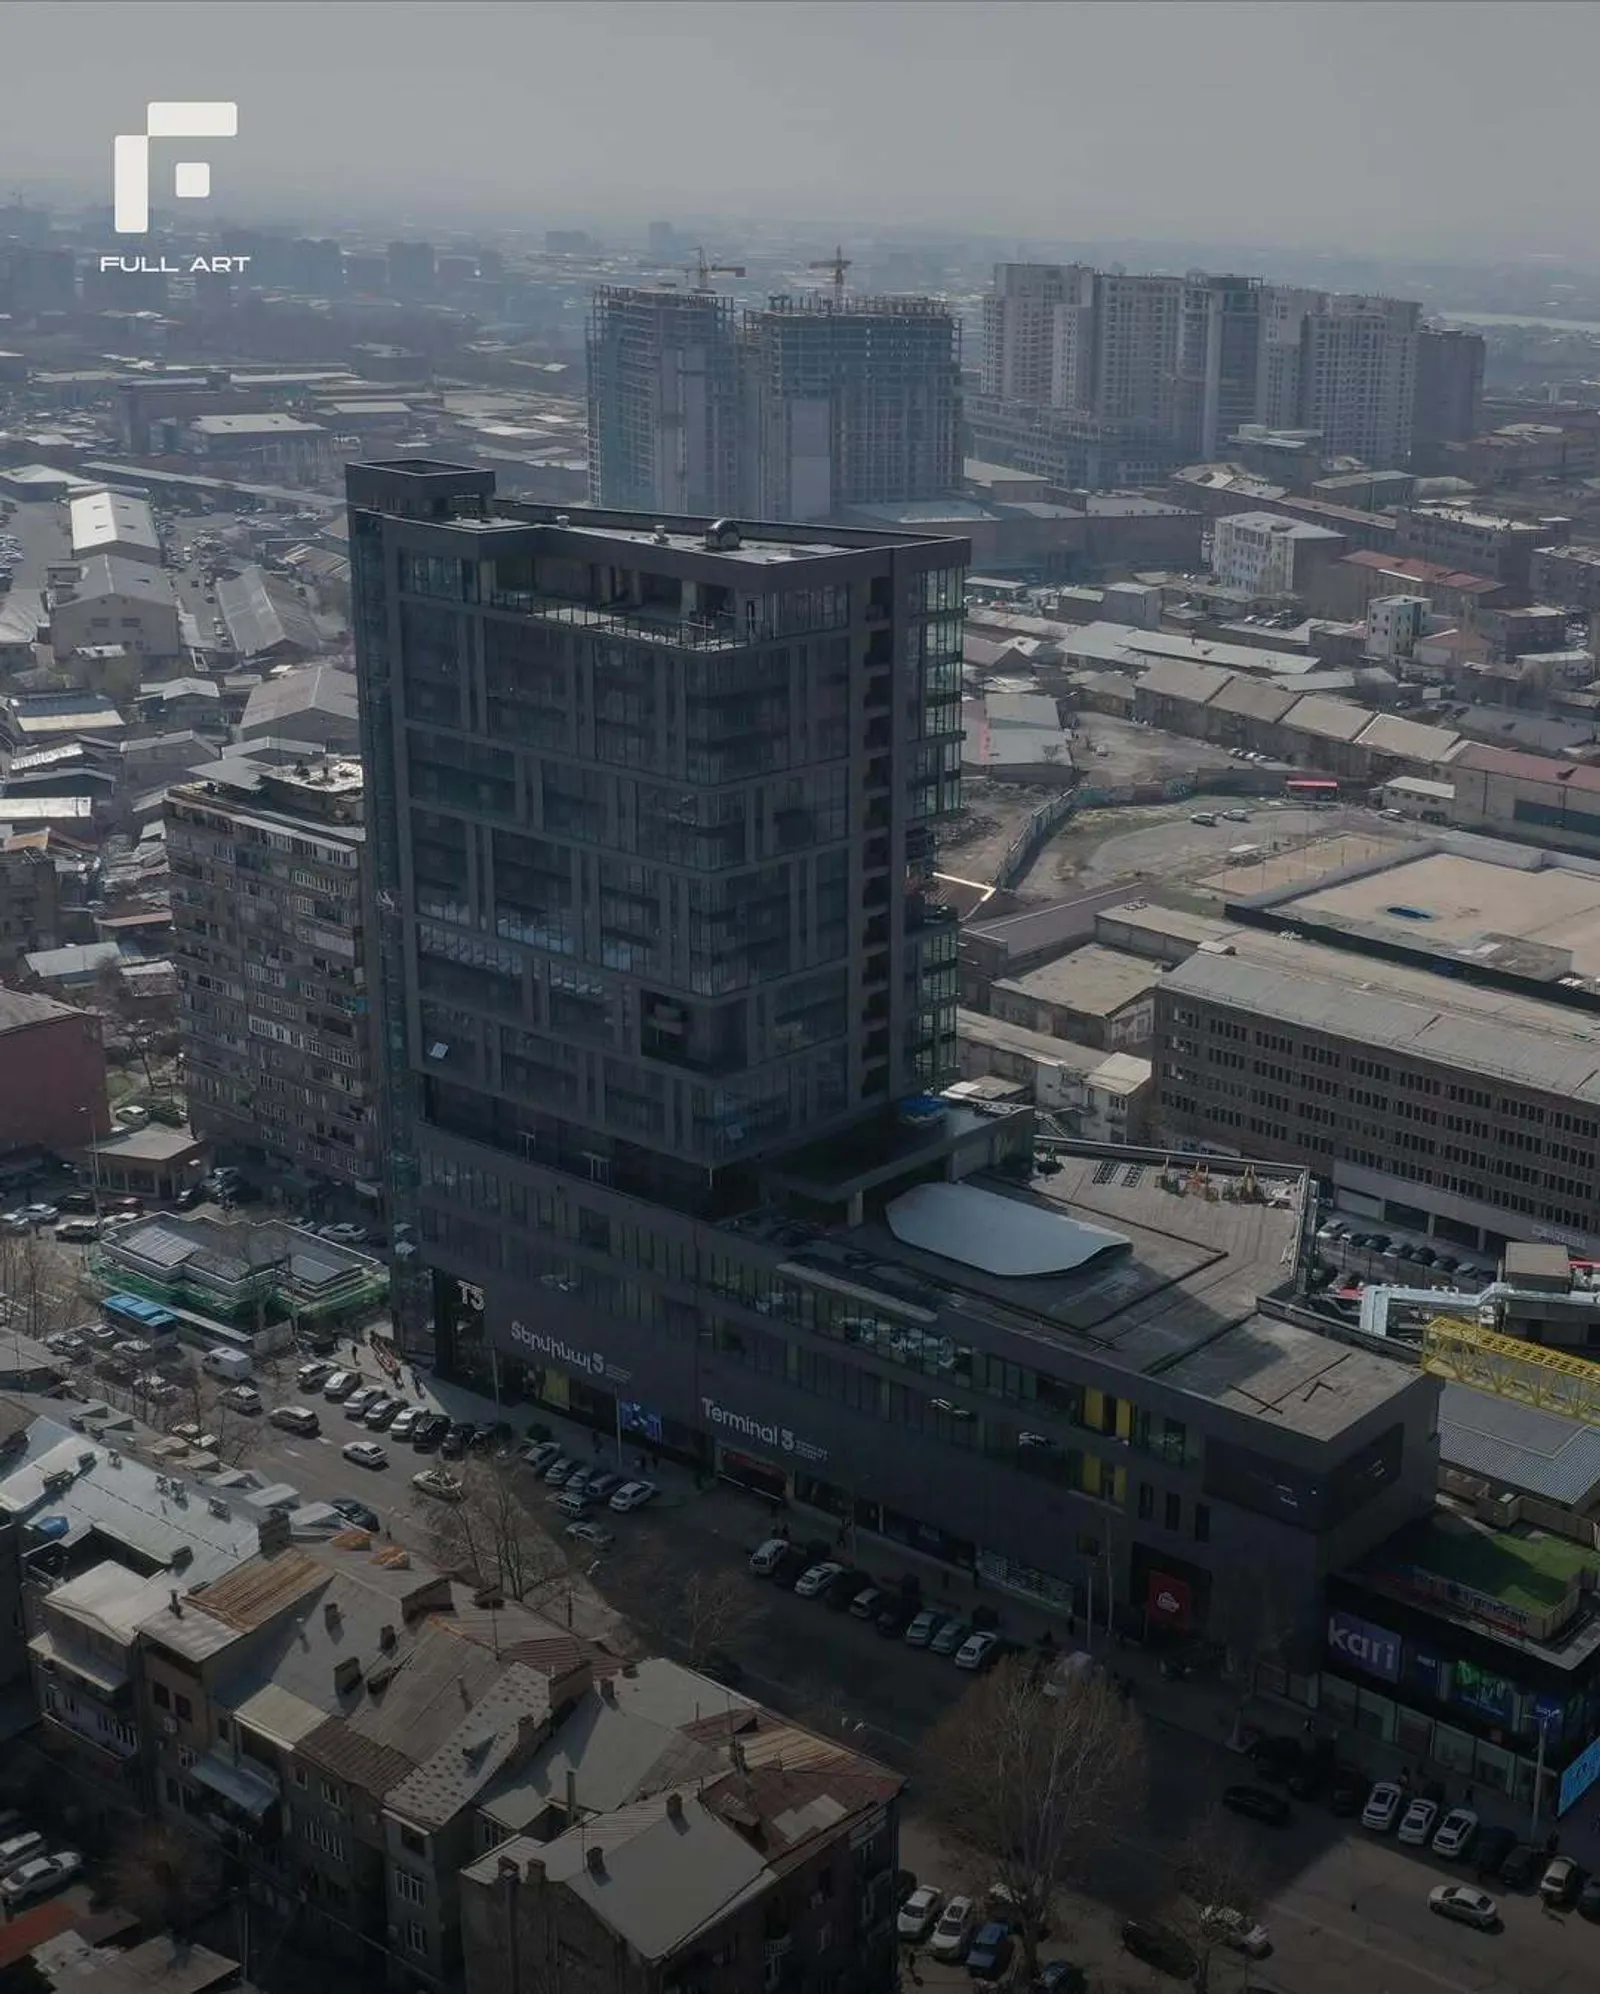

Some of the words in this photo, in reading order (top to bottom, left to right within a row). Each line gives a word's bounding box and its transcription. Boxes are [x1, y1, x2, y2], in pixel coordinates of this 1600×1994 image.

[457, 1280, 485, 1311] T5
[701, 1396, 778, 1447] Terminal
[781, 1428, 796, 1451] 5
[1327, 1615, 1395, 1670] kari
